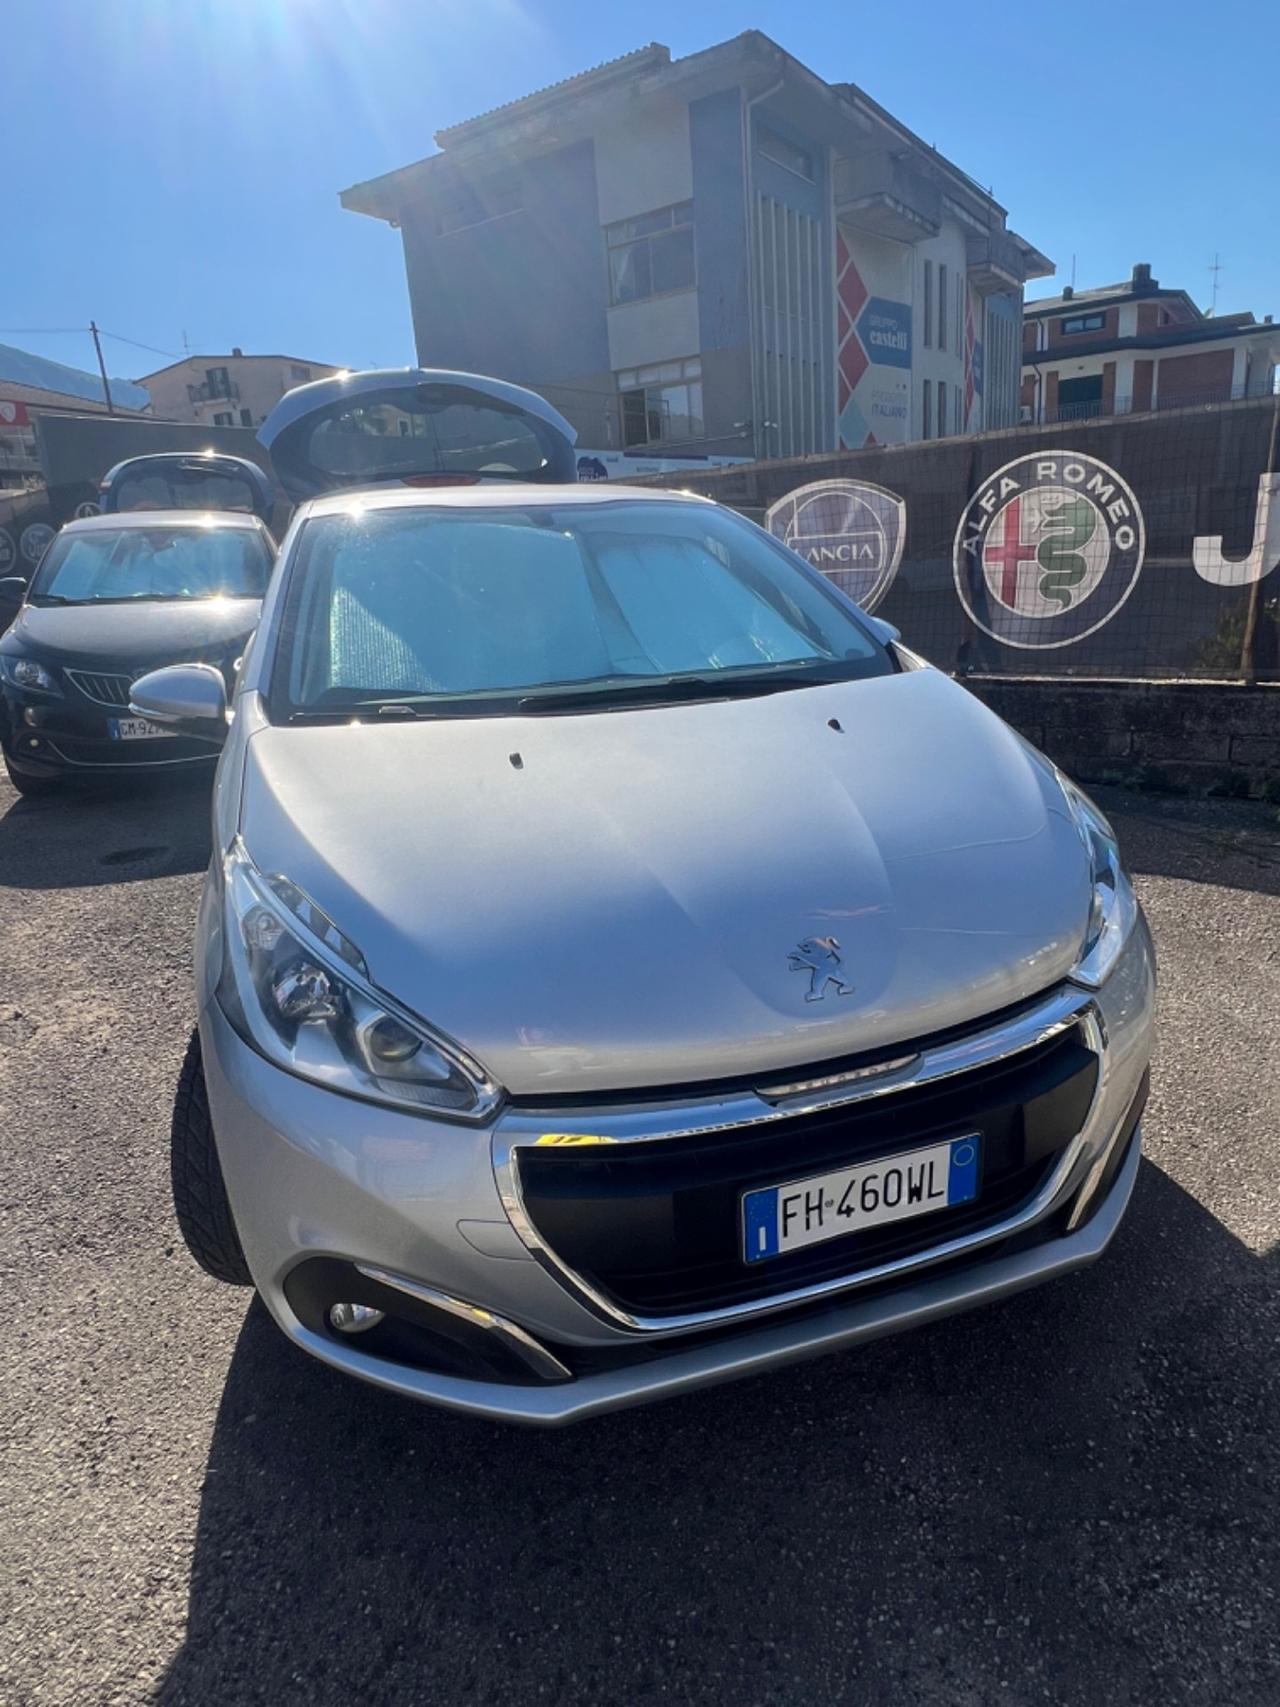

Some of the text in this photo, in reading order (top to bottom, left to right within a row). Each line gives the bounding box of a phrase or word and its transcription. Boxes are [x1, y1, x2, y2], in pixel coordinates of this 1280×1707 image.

[870, 329, 908, 351] castelli
[962, 461, 1135, 557] ALFA ROMEO
[794, 543, 875, 562] ANCIA
